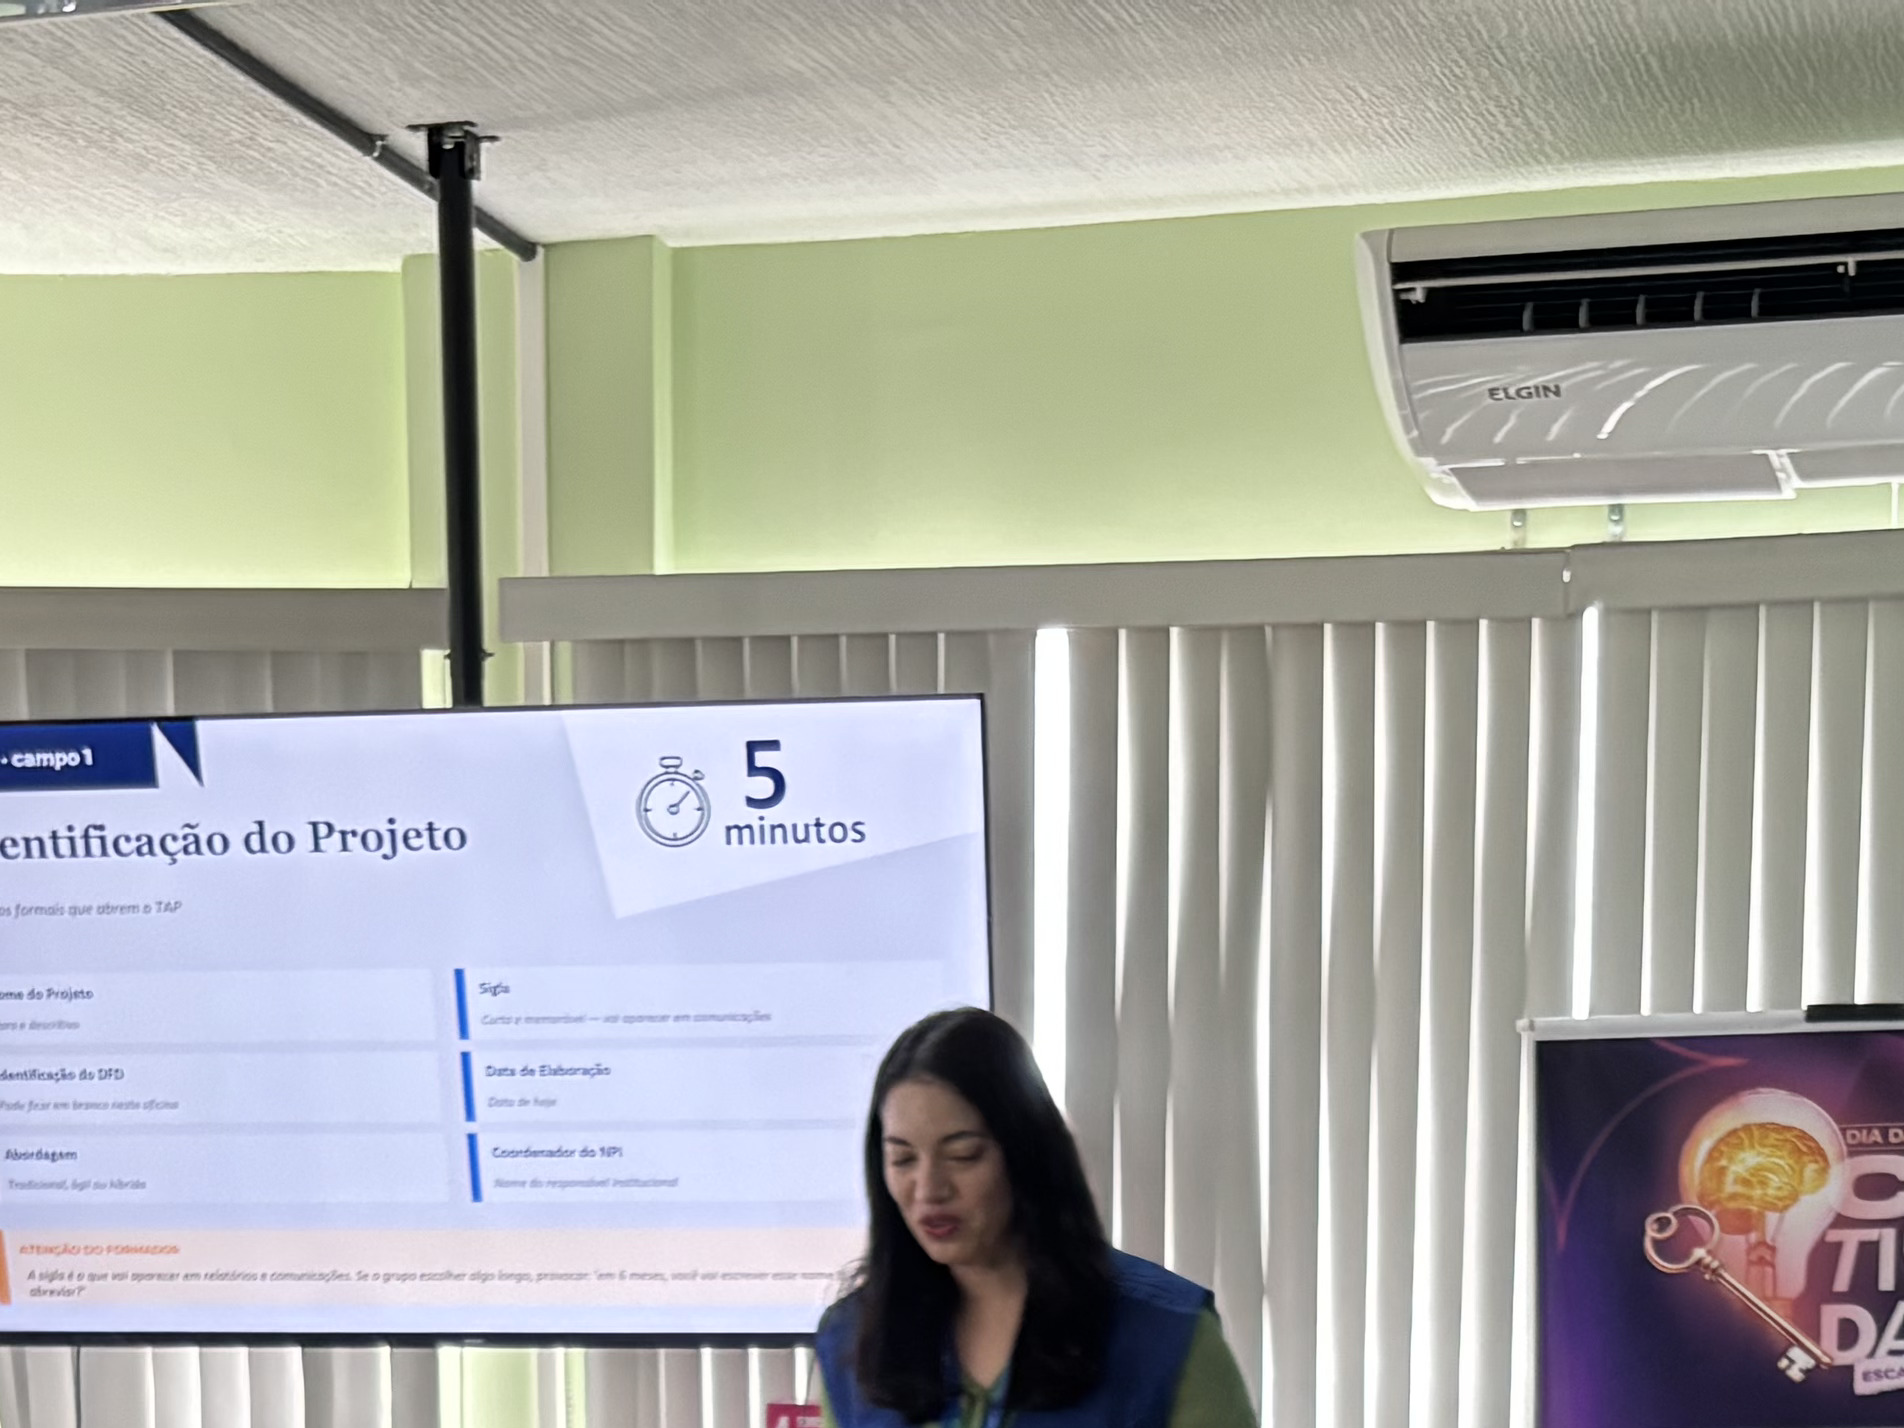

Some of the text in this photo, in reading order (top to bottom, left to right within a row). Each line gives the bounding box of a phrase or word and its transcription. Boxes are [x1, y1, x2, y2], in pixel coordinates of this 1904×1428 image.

[1488, 384, 1561, 401] ELGIN
[11, 749, 80, 771] campo
[82, 748, 94, 766] 1
[745, 739, 786, 810] 5
[243, 820, 296, 855] do
[307, 817, 468, 860] Projeto
[724, 815, 866, 846] minutos
[14, 902, 65, 919] formais
[68, 904, 93, 918] que
[96, 901, 139, 916] abrem
[155, 901, 183, 915] TAP
[26, 988, 43, 1000] do
[45, 987, 94, 1002] Projeto
[479, 982, 510, 997] Sigla
[485, 1063, 612, 1079] Data de Elaboração
[1846, 1128, 1884, 1145] DIA
[5, 1149, 78, 1163] Abordagem
[492, 1146, 576, 1158] Coordenador
